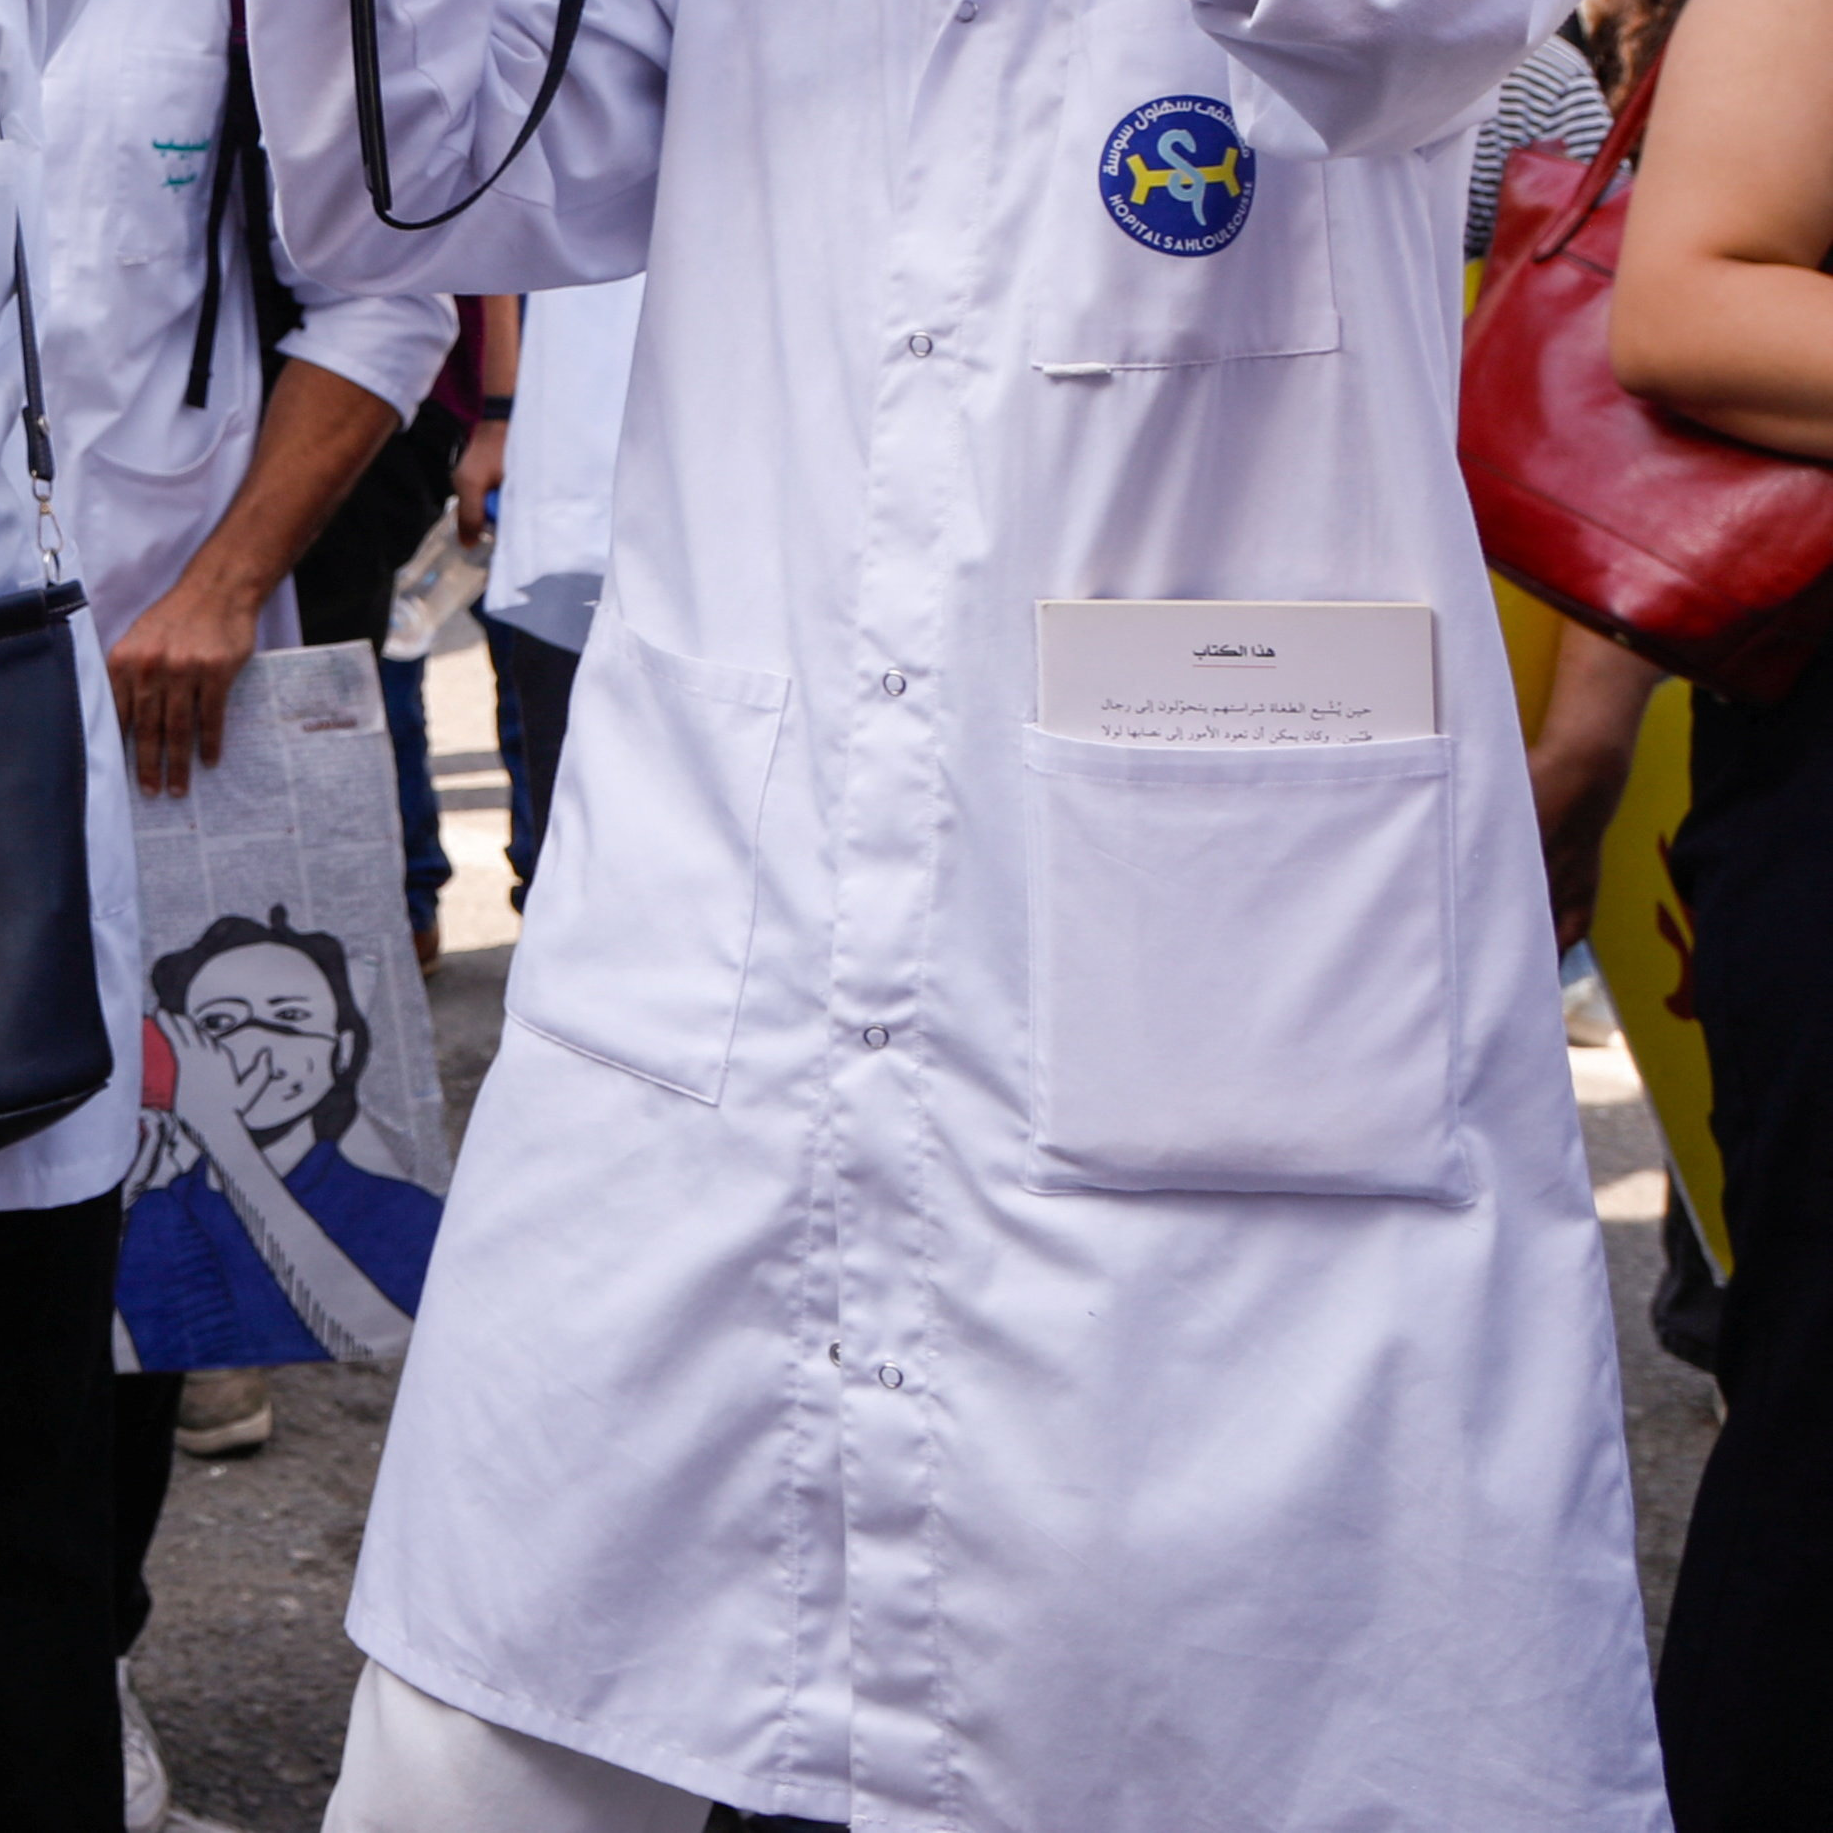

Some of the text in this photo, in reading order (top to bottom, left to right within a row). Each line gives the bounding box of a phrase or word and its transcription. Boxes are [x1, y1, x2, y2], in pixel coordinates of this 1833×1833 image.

[1109, 193, 1161, 246] HOPITAL
[1162, 229, 1232, 253] SAHLOUL
[1192, 643, 1247, 661] الكتاب
